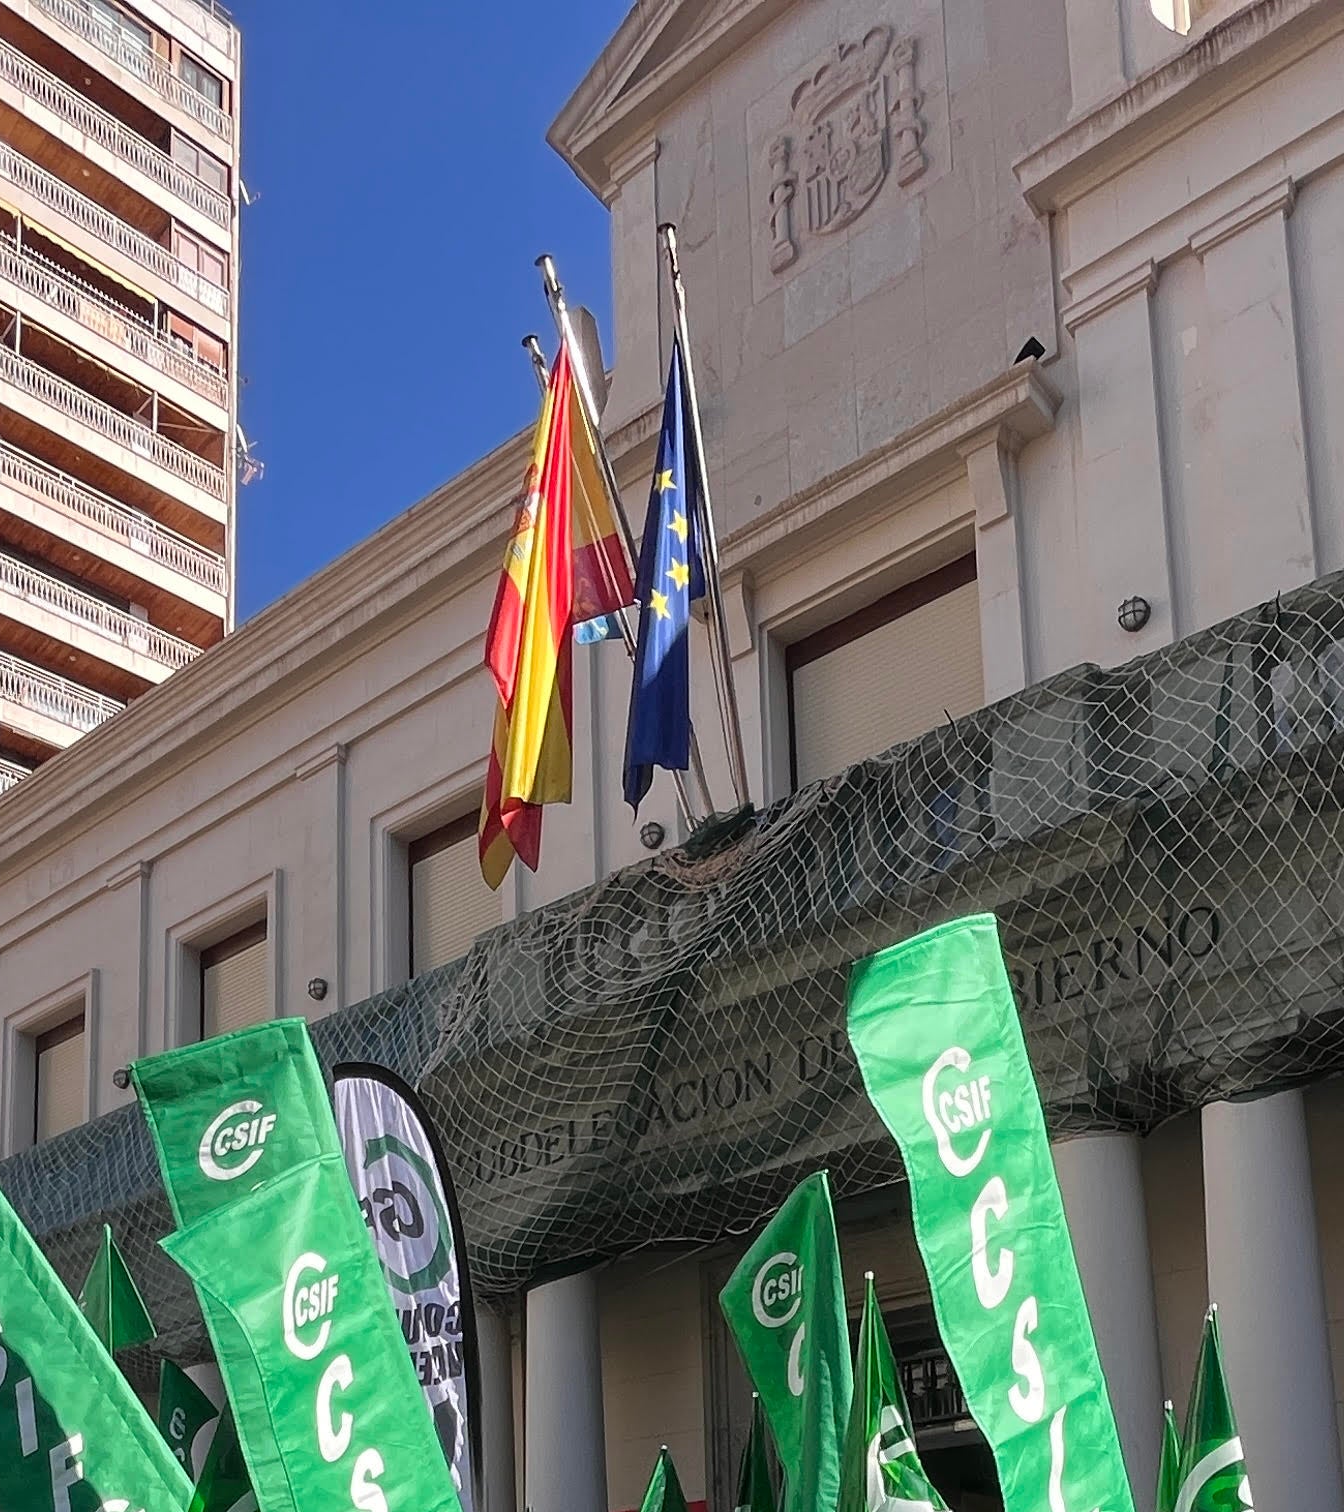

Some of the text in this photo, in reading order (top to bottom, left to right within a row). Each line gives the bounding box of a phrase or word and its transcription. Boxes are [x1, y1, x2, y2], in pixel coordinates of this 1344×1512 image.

[939, 1077, 992, 1131] CSIF
[214, 1114, 276, 1156] CSIF
[294, 1274, 339, 1328] CSIF
